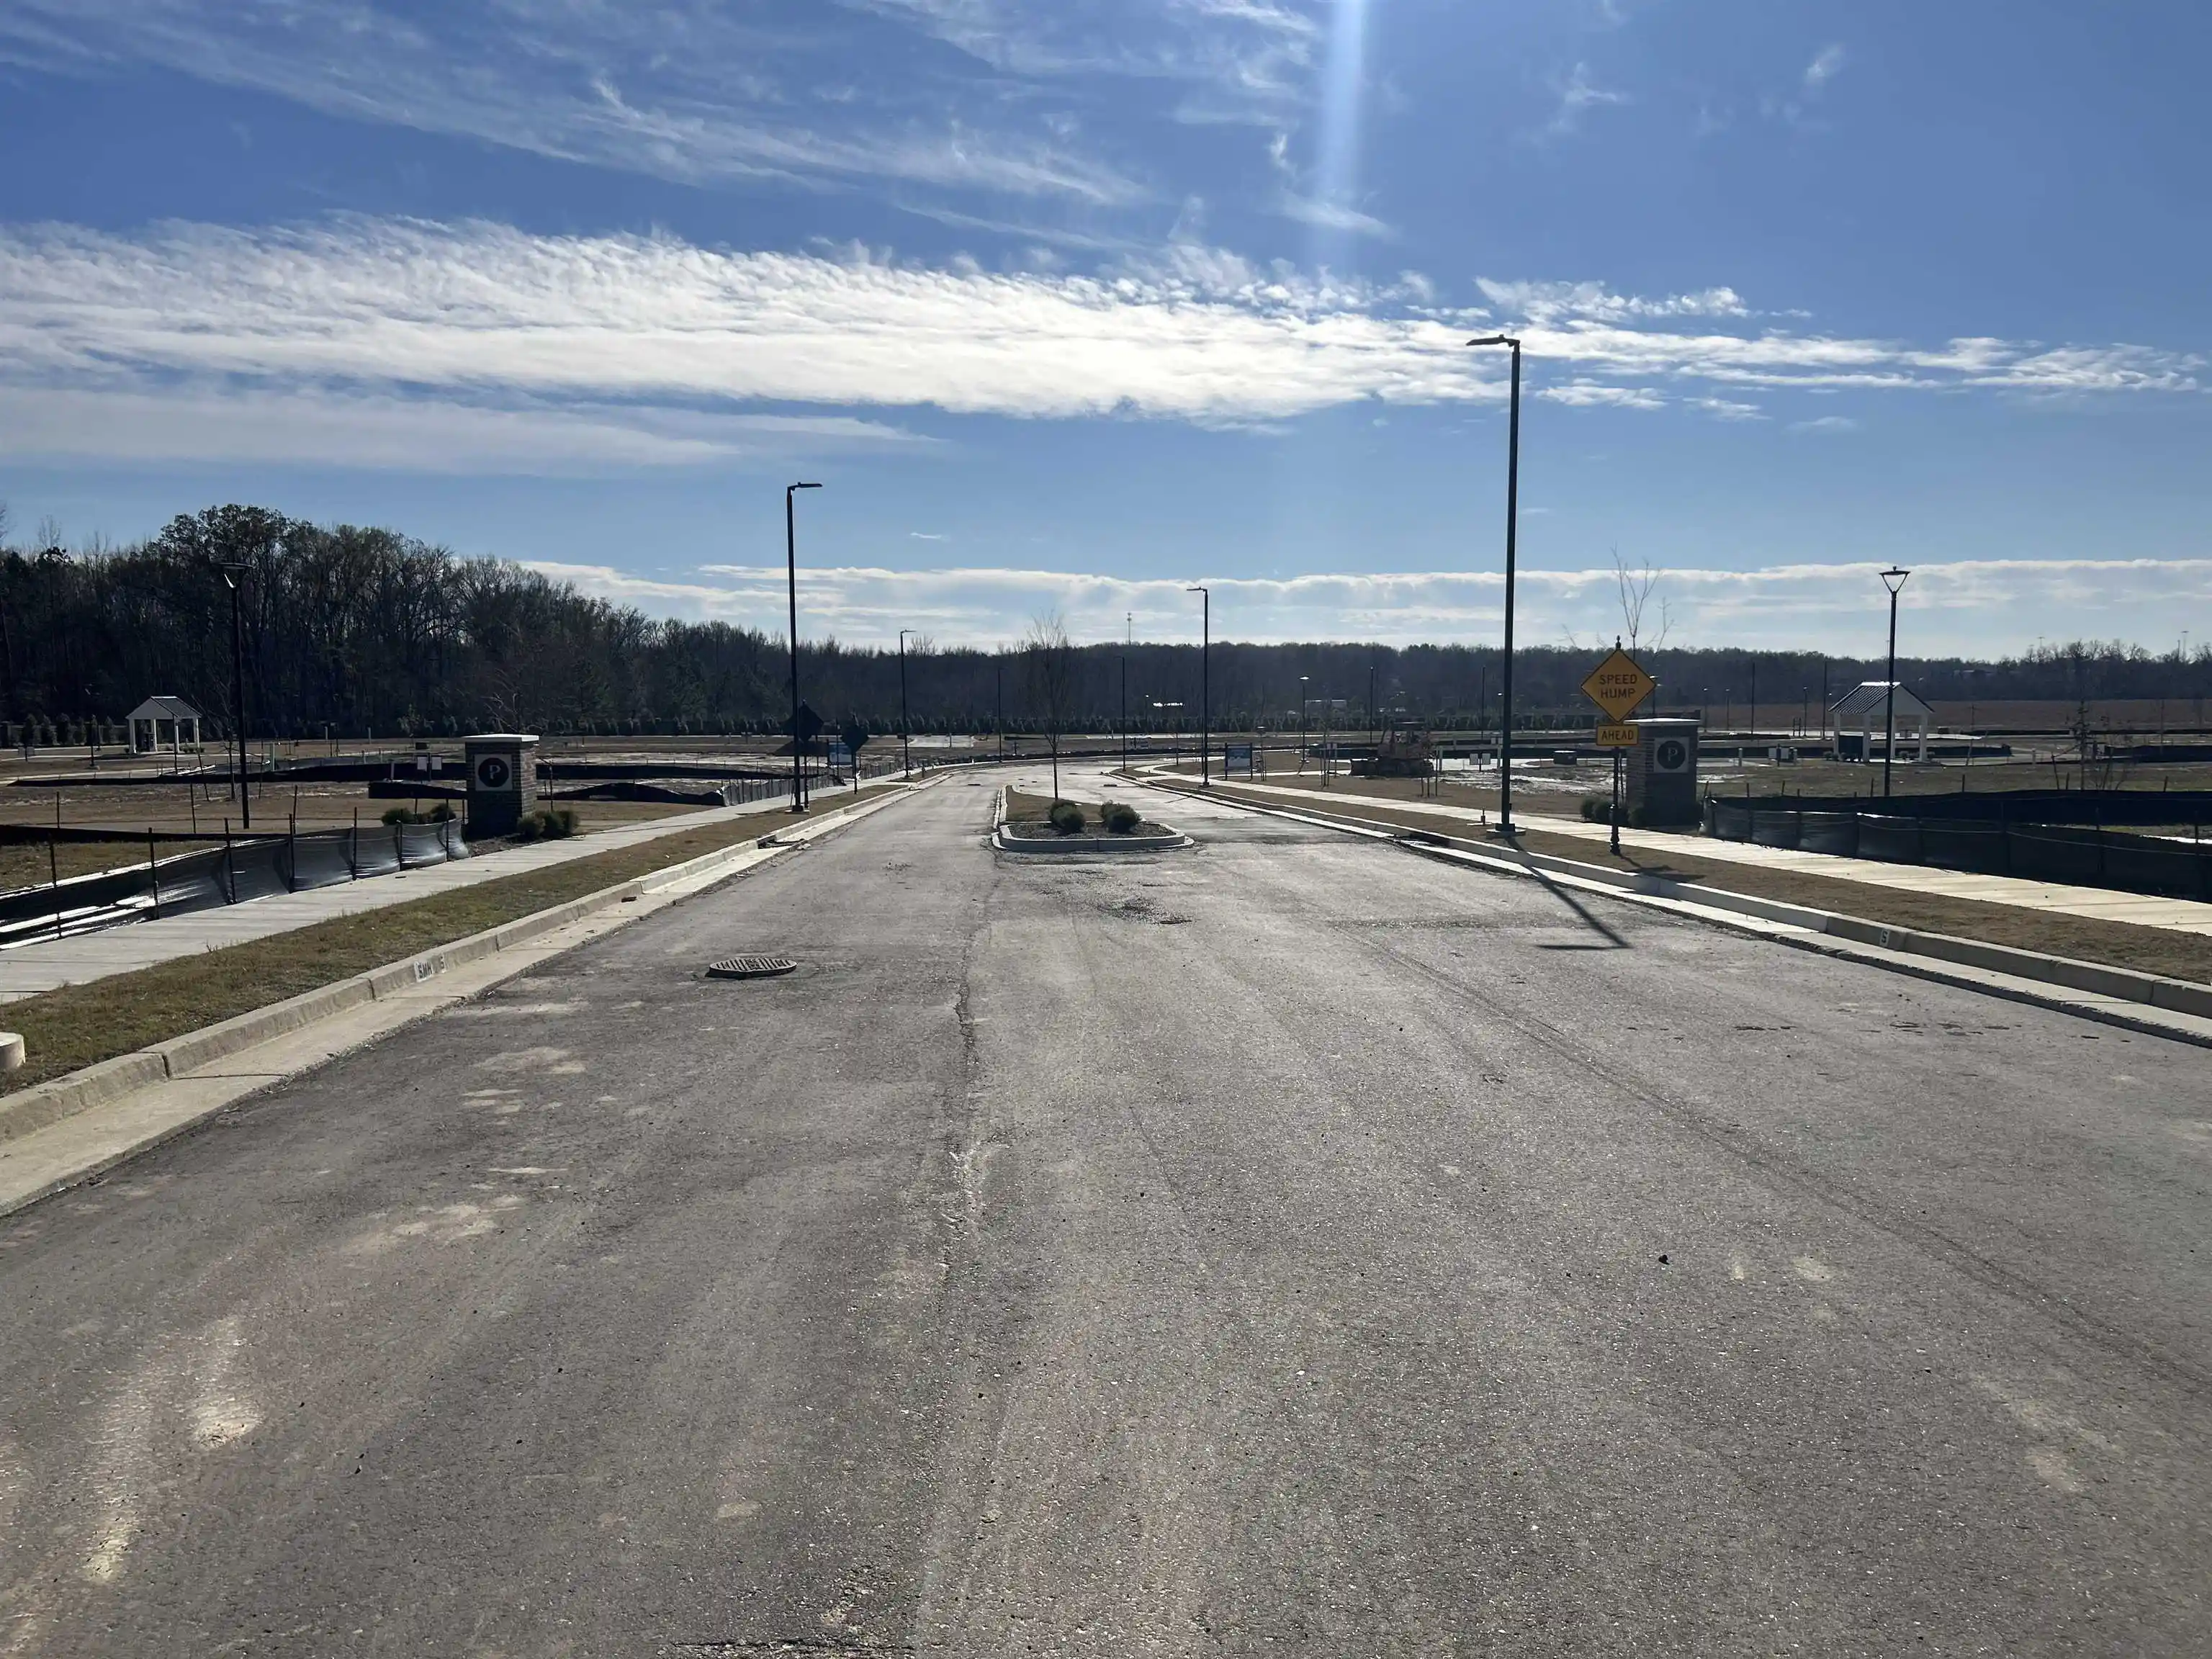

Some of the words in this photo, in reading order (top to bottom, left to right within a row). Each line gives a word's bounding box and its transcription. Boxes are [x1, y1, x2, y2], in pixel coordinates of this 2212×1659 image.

[1599, 673, 1637, 685] SPEED
[1601, 688, 1636, 699] HUMP
[1601, 729, 1634, 741] AHEAD
[490, 765, 501, 780] P
